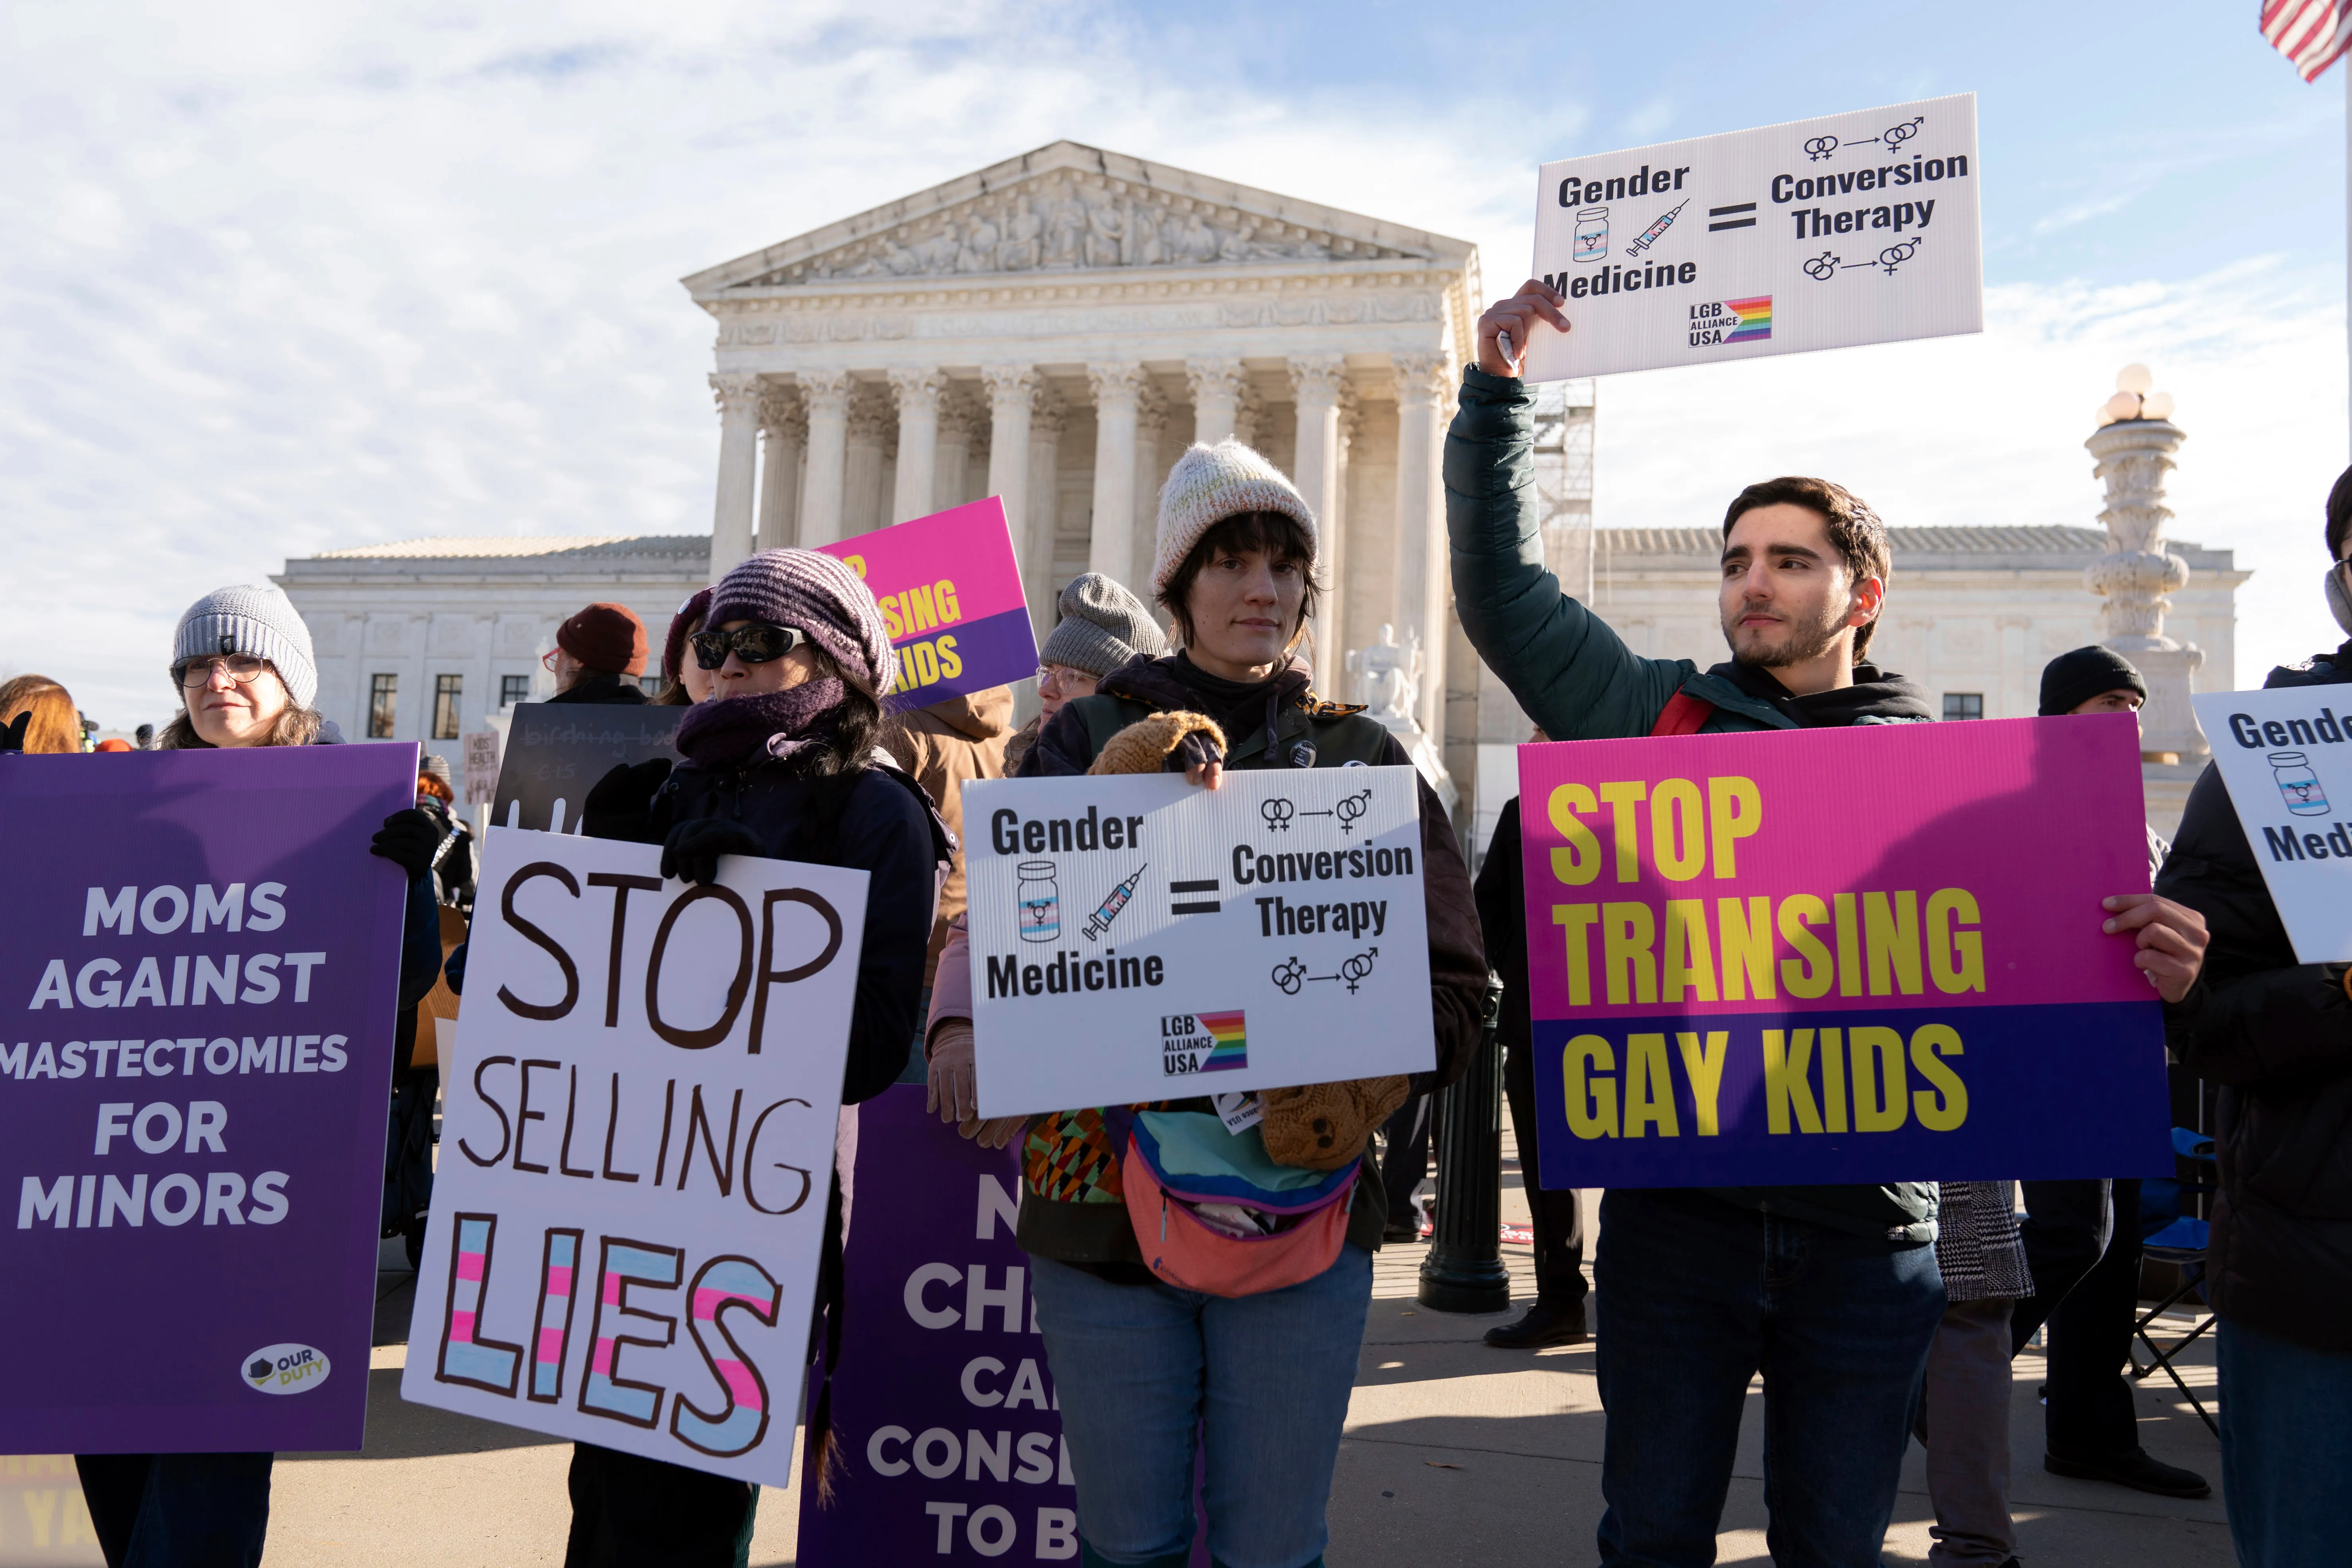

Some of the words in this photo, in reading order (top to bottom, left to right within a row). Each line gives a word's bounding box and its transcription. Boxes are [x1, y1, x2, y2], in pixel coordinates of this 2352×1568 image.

[1558, 165, 1690, 209] Gender
[1771, 154, 1968, 204] Conversion
[1791, 199, 1936, 240] Therapy
[1544, 261, 1696, 300] Medicine
[1691, 303, 1722, 319] LGB
[1691, 317, 1737, 330] ALLIANCE
[1690, 330, 1722, 346] USA
[843, 554, 867, 579] P
[878, 580, 961, 639] SING
[525, 722, 626, 759] birthing
[640, 721, 680, 746] bod
[1300, 745, 1313, 754] lesbian
[991, 805, 1144, 855] Gender
[1548, 776, 1762, 887] STOP
[1232, 840, 1413, 885] Conversion
[83, 882, 287, 936] MOMS
[1255, 897, 1387, 939] Therapy
[497, 862, 843, 1055] STOP
[1552, 887, 1986, 1007] TRANSING
[28, 952, 326, 1009] AGAINST
[987, 950, 1164, 999] Medicine
[1162, 1015, 1195, 1037] LGB
[1165, 1036, 1212, 1052] ALLIANCE
[0, 1034, 348, 1080] MASTECTOMIES
[1165, 1052, 1198, 1074] USA
[1562, 1031, 1729, 1140] GAY
[1762, 1023, 1969, 1135] KIDS
[94, 1101, 227, 1155] FOR
[458, 1055, 812, 1215] SELLING
[1226, 1115, 1243, 1126] USA
[1241, 1106, 1259, 1119] ance
[17, 1171, 290, 1229] MINORS
[976, 1174, 1022, 1240] N
[903, 1262, 1042, 1334] CH
[435, 1212, 783, 1457] LIES
[278, 1349, 313, 1371] OUR
[280, 1358, 324, 1386] DUTY
[961, 1356, 1060, 1411] CA
[867, 1425, 1076, 1486] CONS
[925, 1502, 1016, 1556] TO
[1035, 1507, 1078, 1560] B
